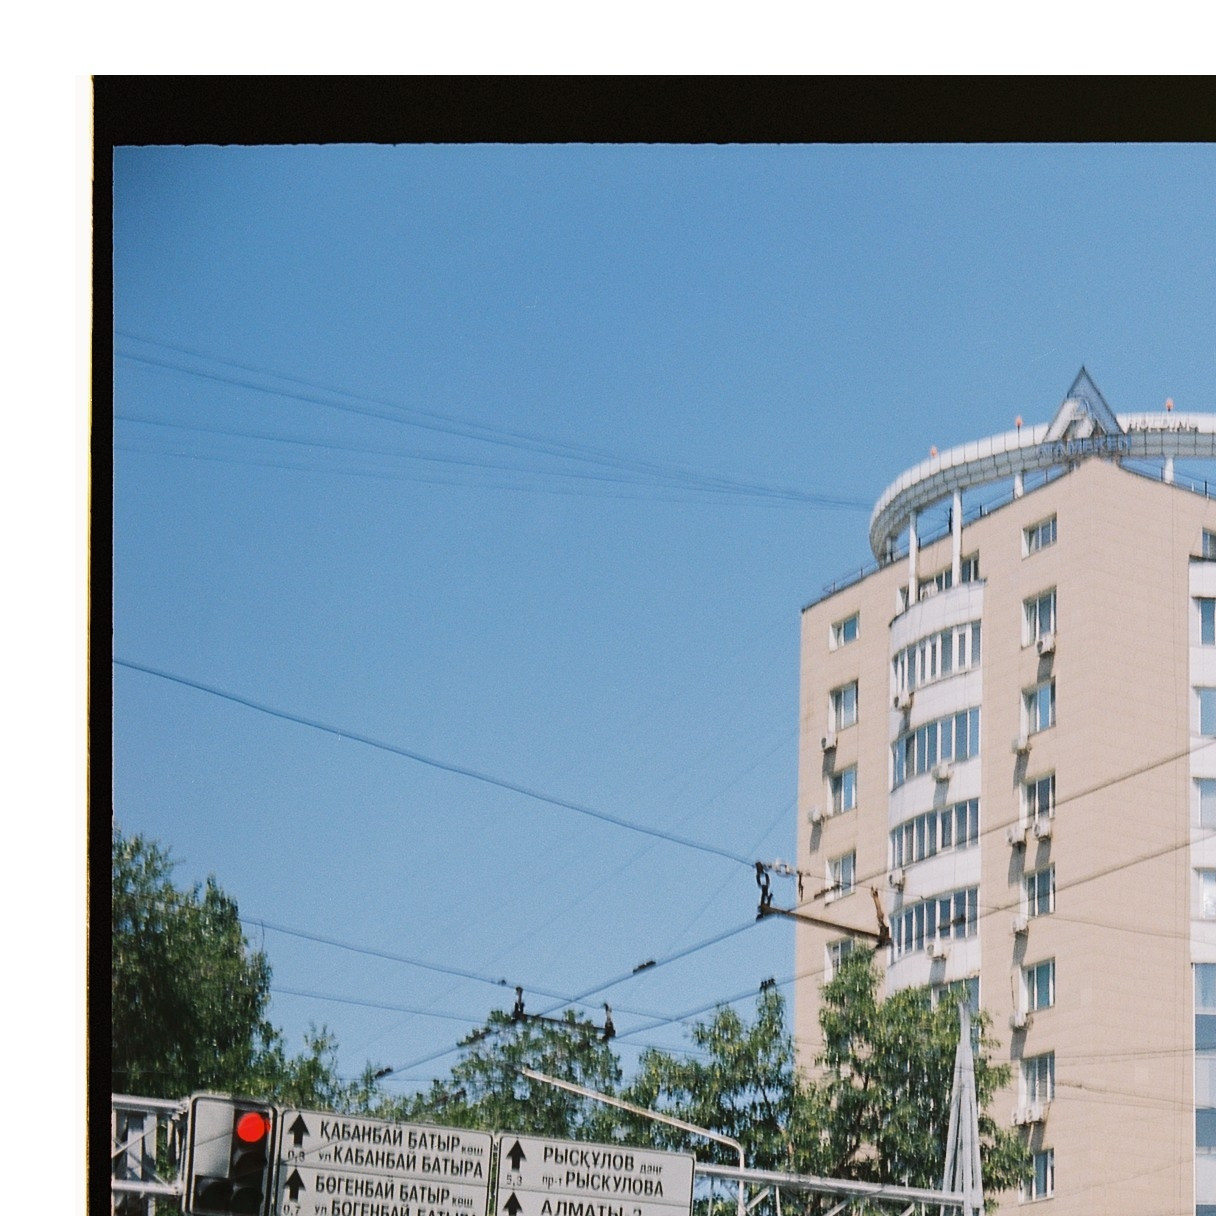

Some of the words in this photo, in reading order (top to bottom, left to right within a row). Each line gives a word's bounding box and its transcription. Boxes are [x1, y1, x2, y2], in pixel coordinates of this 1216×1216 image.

[320, 1120, 403, 1147] ҚАБАНБАЙ
[408, 1131, 460, 1153] БАТЫР
[333, 1145, 417, 1172] КАБАНБАЙ
[422, 1155, 483, 1178] БАТЫРА
[399, 1184, 450, 1205] БАТЫР
[565, 1171, 664, 1198] РЫСКУЛОВА
